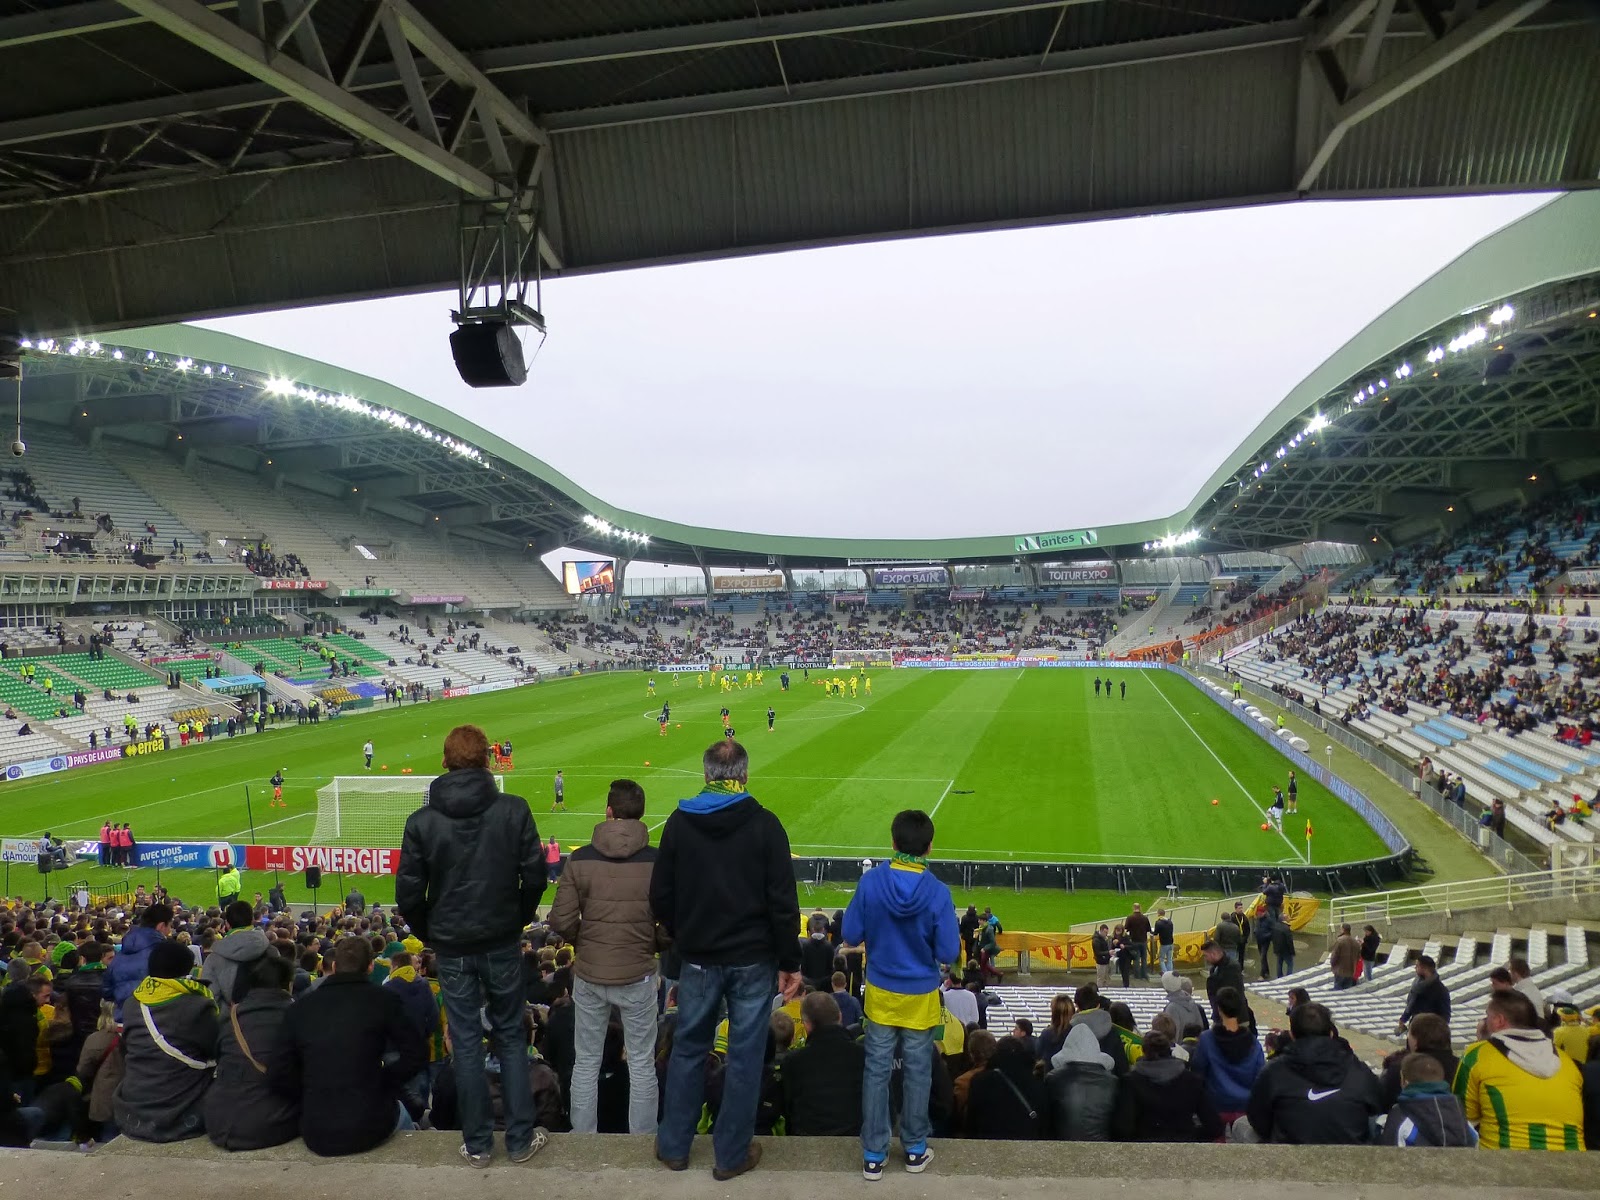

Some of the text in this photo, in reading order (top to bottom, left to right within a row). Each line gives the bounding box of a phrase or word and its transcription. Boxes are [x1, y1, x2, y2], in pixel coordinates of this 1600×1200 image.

[1023, 533, 1075, 550] Nantes
[449, 687, 470, 697] SYNERGIE
[74, 748, 121, 765] PAYS DE LA LOIRE
[17, 841, 36, 853] Côte
[140, 846, 182, 861] AVEC VOUS
[2, 851, 36, 861] d'Amour
[173, 852, 198, 864] SPORT
[214, 848, 230, 866] U
[292, 847, 391, 873] SYNERGIE
